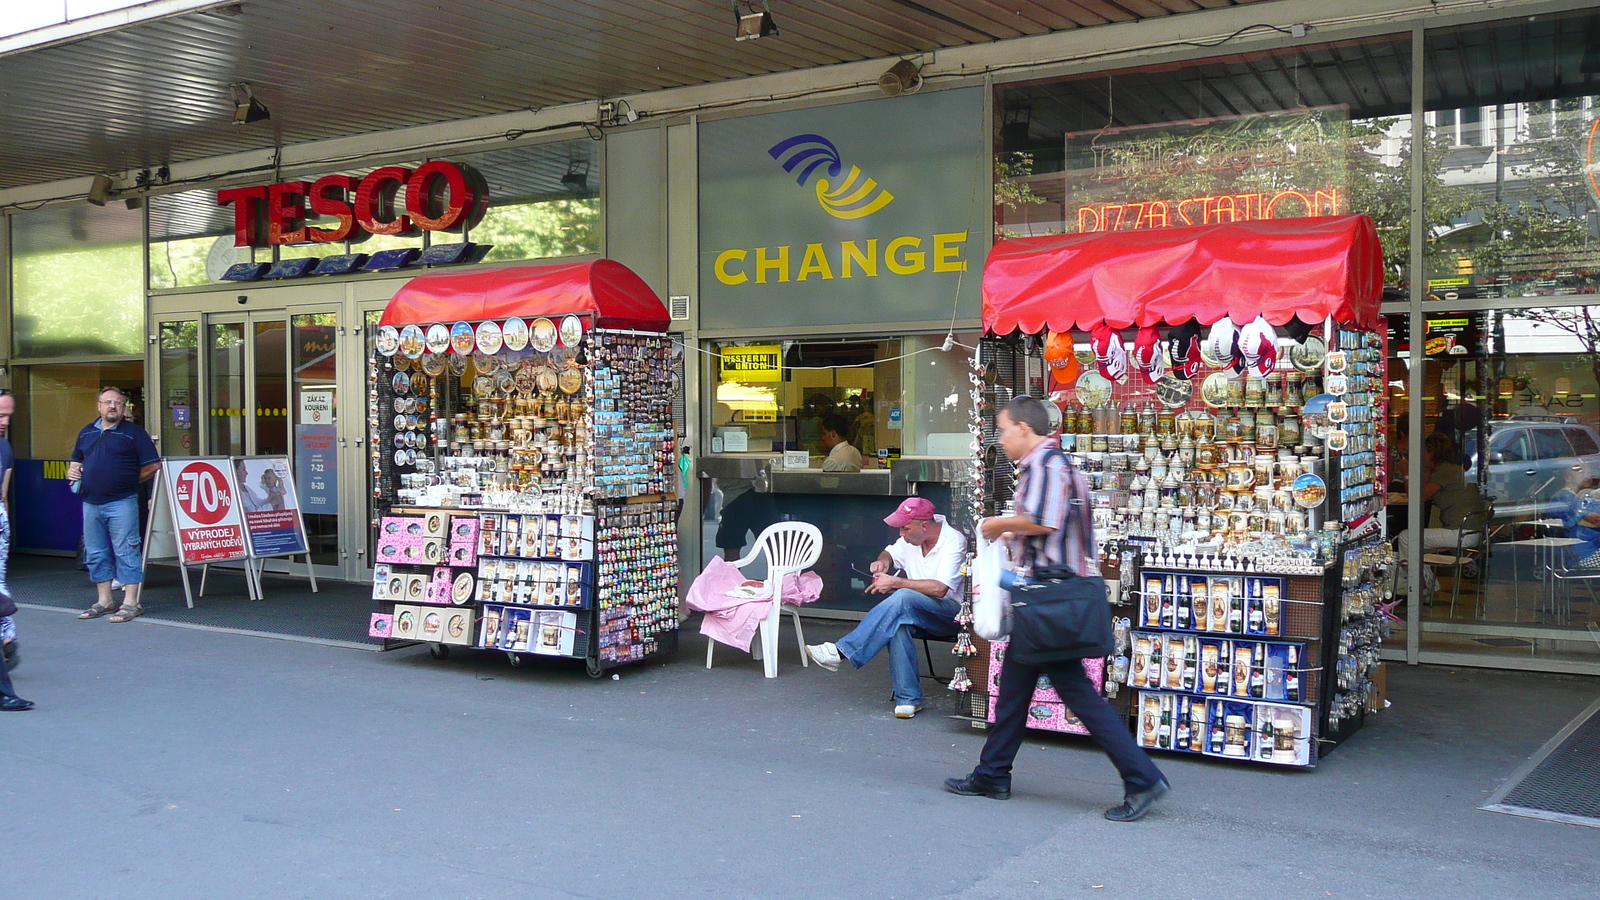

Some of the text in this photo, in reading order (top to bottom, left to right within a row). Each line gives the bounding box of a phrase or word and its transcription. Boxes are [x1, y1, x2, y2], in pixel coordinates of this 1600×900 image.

[217, 160, 477, 247] TESCO
[1078, 188, 1339, 233] PIZZA STATION
[714, 230, 968, 285] CHANGE
[724, 354, 767, 363] WESTERN
[735, 362, 767, 370] UNION
[307, 395, 326, 403] ZÁKAZ
[304, 402, 329, 411] KOUŘENÍ
[177, 485, 188, 494] AŽ
[187, 528, 235, 540] VÝPRODEJ
[183, 539, 221, 552] VYBRANÝCH
[222, 534, 243, 548] ODĚVŮ
